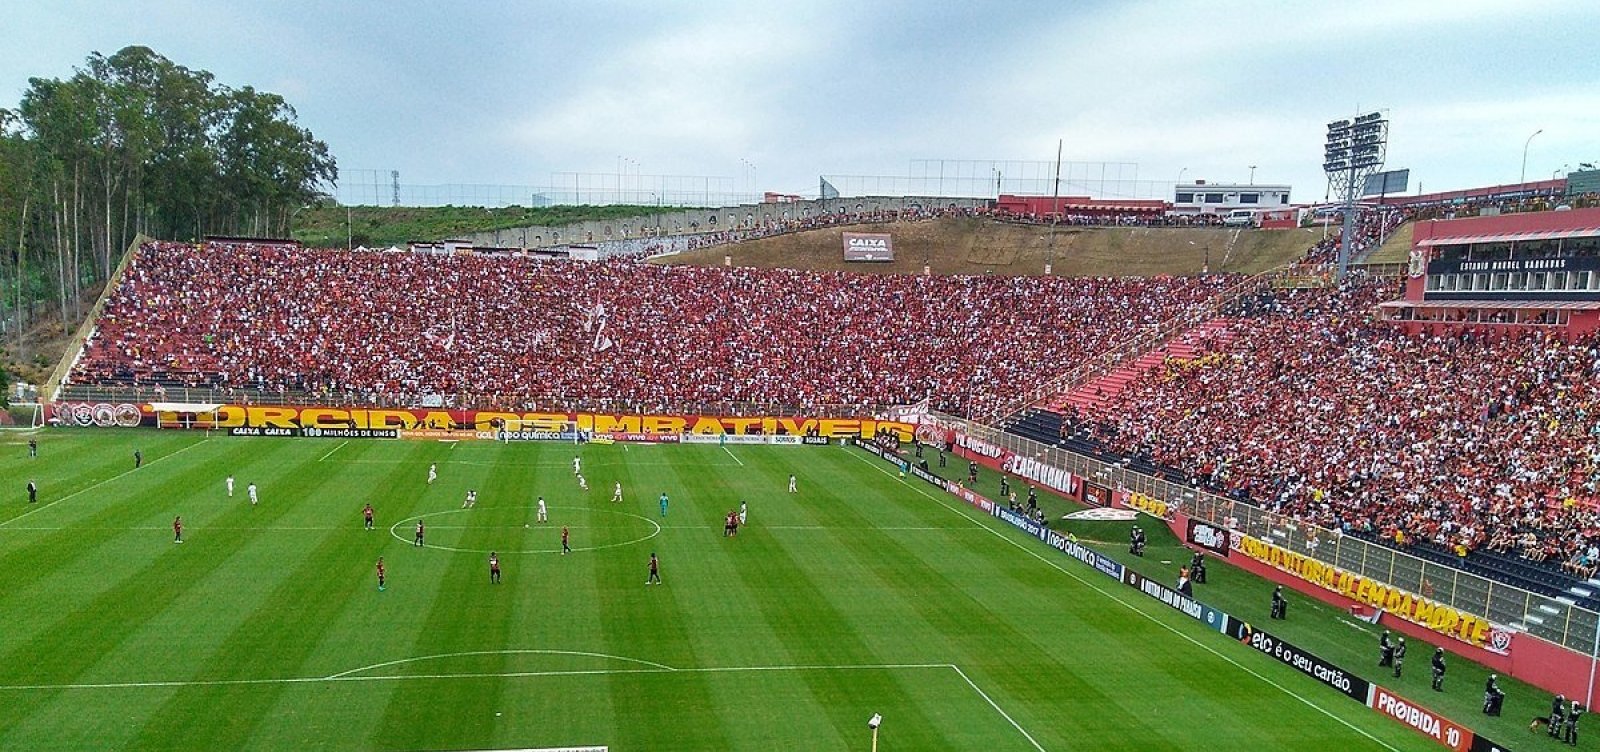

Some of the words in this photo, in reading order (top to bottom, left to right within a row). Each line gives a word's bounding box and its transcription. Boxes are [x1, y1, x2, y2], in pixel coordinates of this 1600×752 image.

[849, 239, 886, 247] CAIXA
[264, 428, 292, 436] CAIXA
[302, 427, 322, 437] 100
[323, 428, 359, 437] MILHÕES
[499, 430, 520, 440] neo
[521, 429, 560, 441] química
[1050, 532, 1065, 549] neo
[1065, 537, 1096, 565] química
[1387, 590, 1413, 617] DA
[1415, 597, 1490, 648] MORTE
[1252, 632, 1272, 653] elo
[1275, 642, 1282, 657] é
[1283, 650, 1292, 662] o
[1293, 653, 1313, 673] seu
[1314, 664, 1352, 693] cartão.
